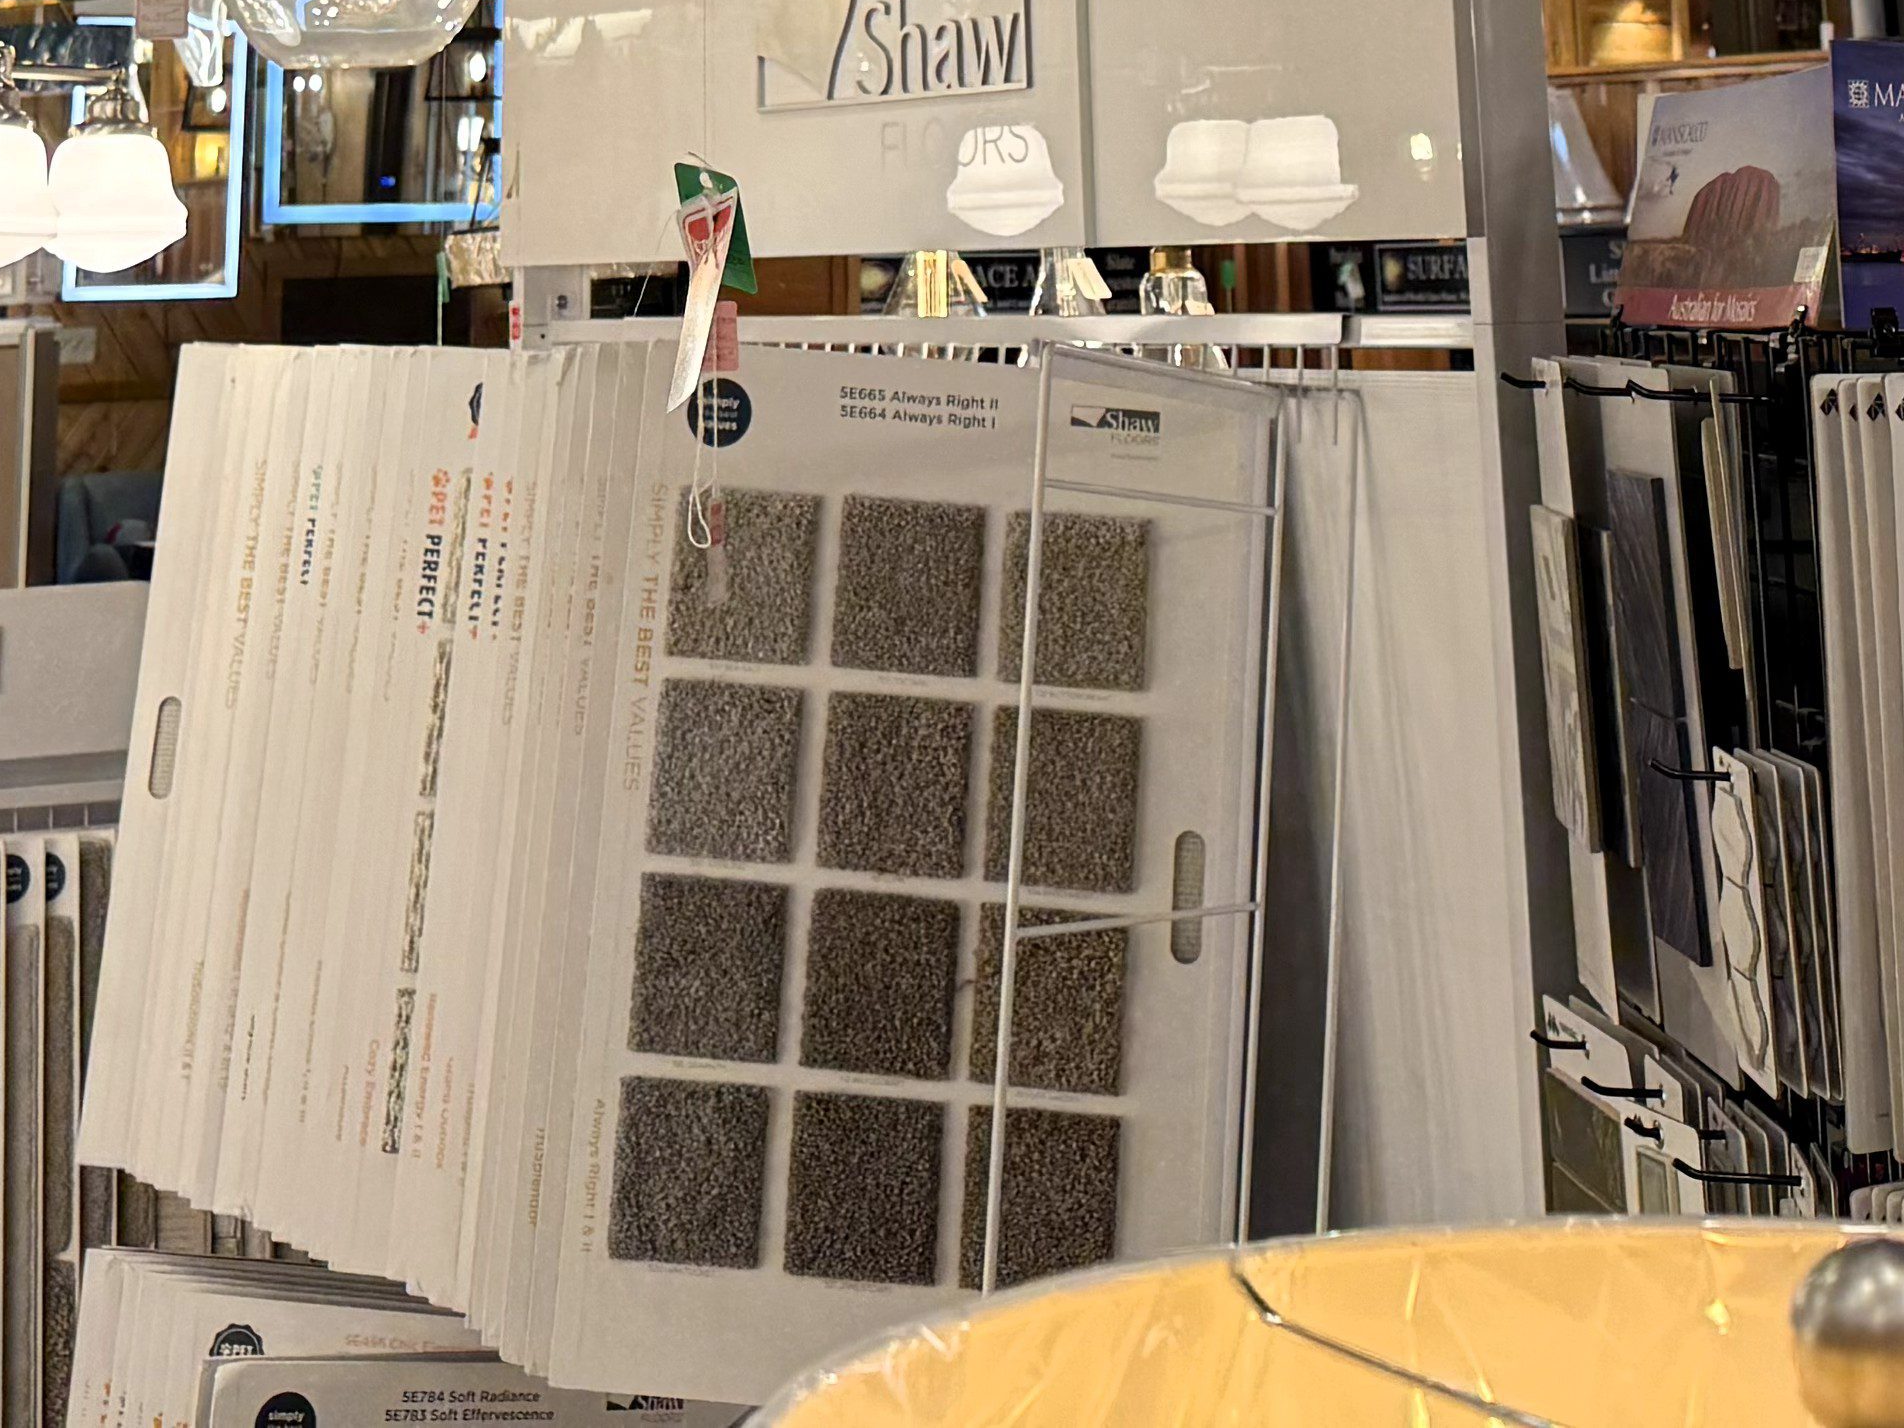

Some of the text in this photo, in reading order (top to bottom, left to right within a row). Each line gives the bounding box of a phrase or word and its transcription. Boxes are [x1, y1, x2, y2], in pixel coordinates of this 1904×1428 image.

[890, 391, 941, 408] Always
[946, 394, 985, 410] Right
[891, 410, 943, 427] Always
[947, 414, 986, 429] Right
[1106, 410, 1156, 433] Shaw
[429, 491, 446, 526] PET
[226, 458, 268, 710] SIMPLY THE BEST VALUES
[624, 482, 668, 790] SIMPLY THE BEST VALUES
[589, 1099, 606, 1157] Always
[584, 1163, 601, 1207] Right
[449, 1390, 474, 1403] Soft
[480, 1390, 541, 1403] Radiance
[431, 1408, 457, 1422] Soft
[463, 1409, 554, 1422] Effervescence
